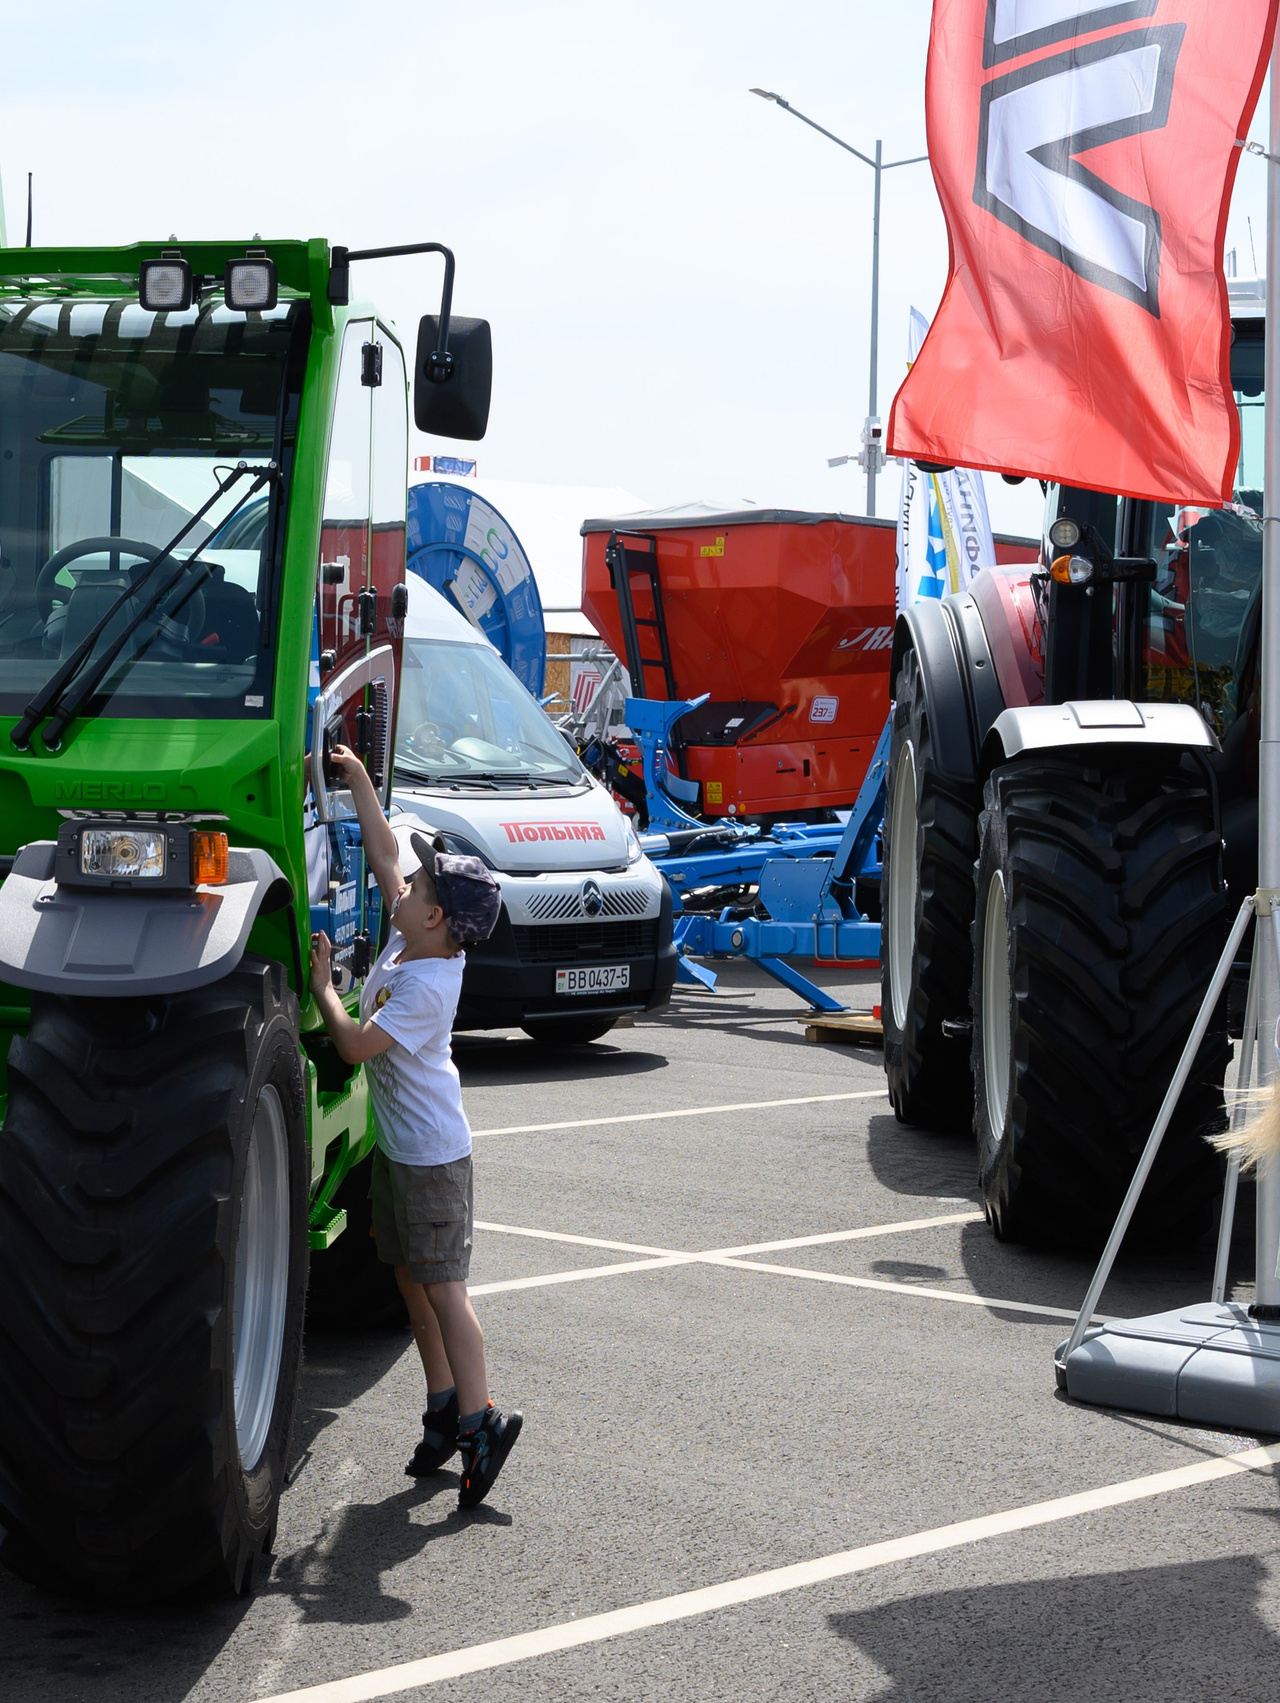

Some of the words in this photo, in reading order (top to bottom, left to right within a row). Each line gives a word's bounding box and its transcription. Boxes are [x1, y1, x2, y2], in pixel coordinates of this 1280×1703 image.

[812, 707, 829, 718] 237
[55, 780, 168, 801] MERLO
[499, 821, 606, 844] Полымя
